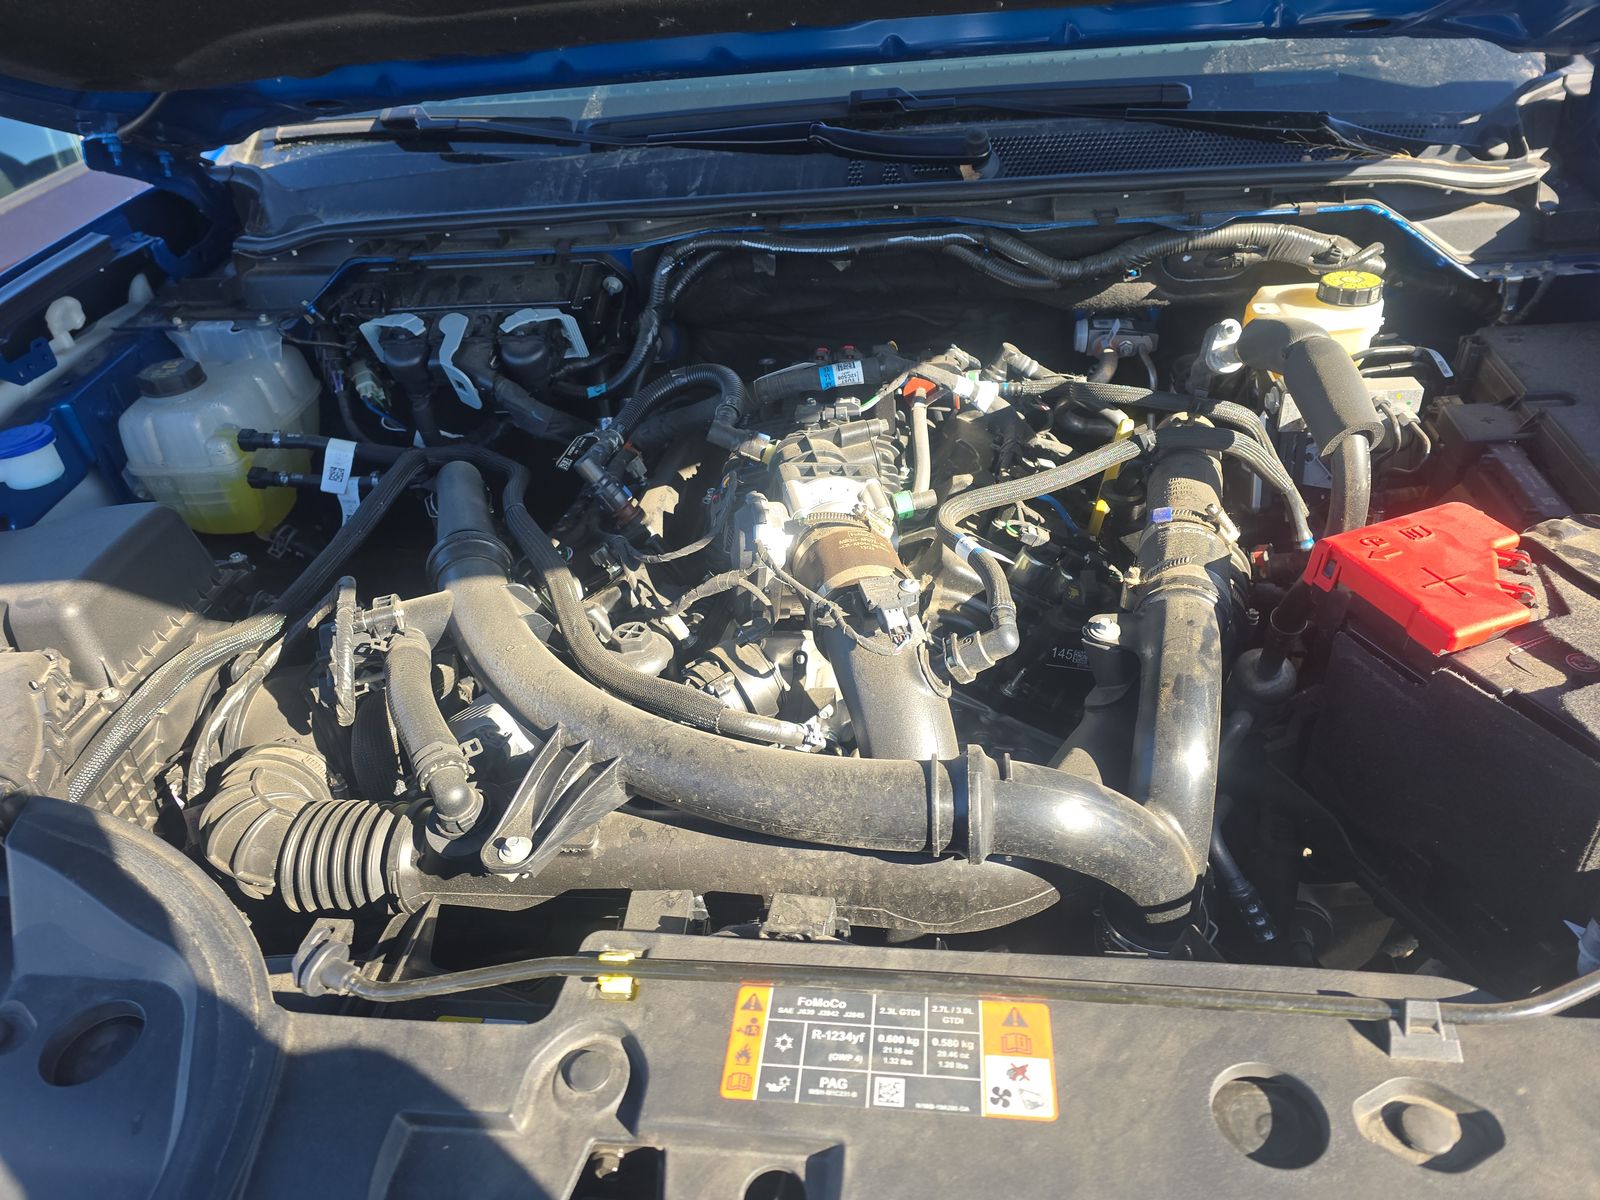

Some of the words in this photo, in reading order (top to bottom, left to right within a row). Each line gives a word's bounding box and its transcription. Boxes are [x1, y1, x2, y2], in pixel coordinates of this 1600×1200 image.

[1052, 647, 1074, 660] 145
[797, 996, 847, 1009] FoMoCo
[879, 1007, 897, 1015] 2.3L
[942, 1016, 964, 1024] GTDI
[811, 1029, 866, 1045] R-1234yf
[877, 1034, 905, 1044] 0.600
[906, 1036, 920, 1047] kg
[931, 1037, 959, 1047] 0.580
[961, 1040, 975, 1050] kg
[819, 1076, 848, 1090] PAG
